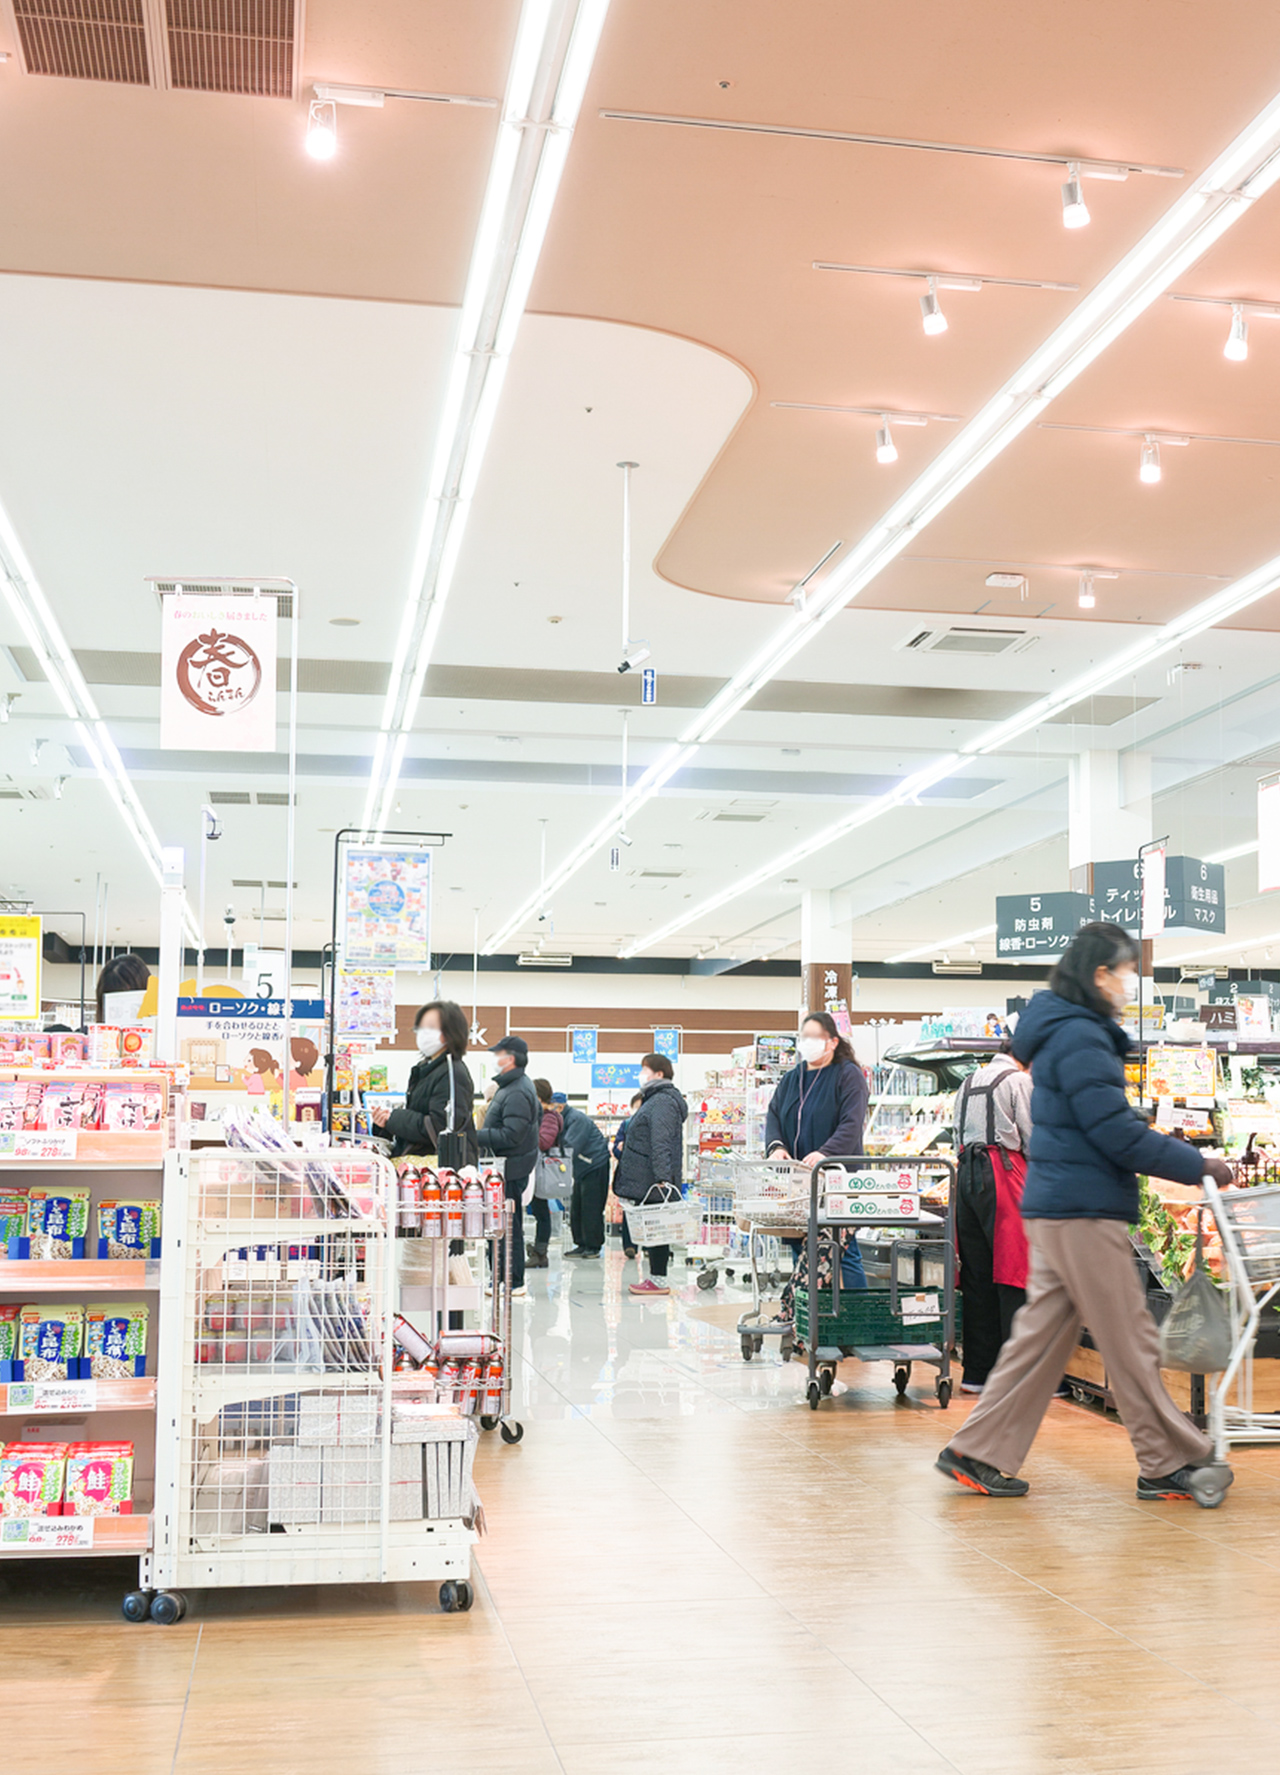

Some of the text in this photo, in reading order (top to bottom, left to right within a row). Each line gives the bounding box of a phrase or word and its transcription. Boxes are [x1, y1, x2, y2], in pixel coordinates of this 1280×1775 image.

[189, 627, 249, 688] 春
[1200, 865, 1208, 880] 6
[1190, 885, 1219, 905] 衛生用品
[1029, 897, 1042, 912] 5
[1014, 917, 1054, 932] 防虫剤
[1194, 908, 1216, 925] マスク
[256, 972, 274, 1000] 5
[1229, 983, 1239, 994] 2
[86, 1466, 107, 1490] 鮭
